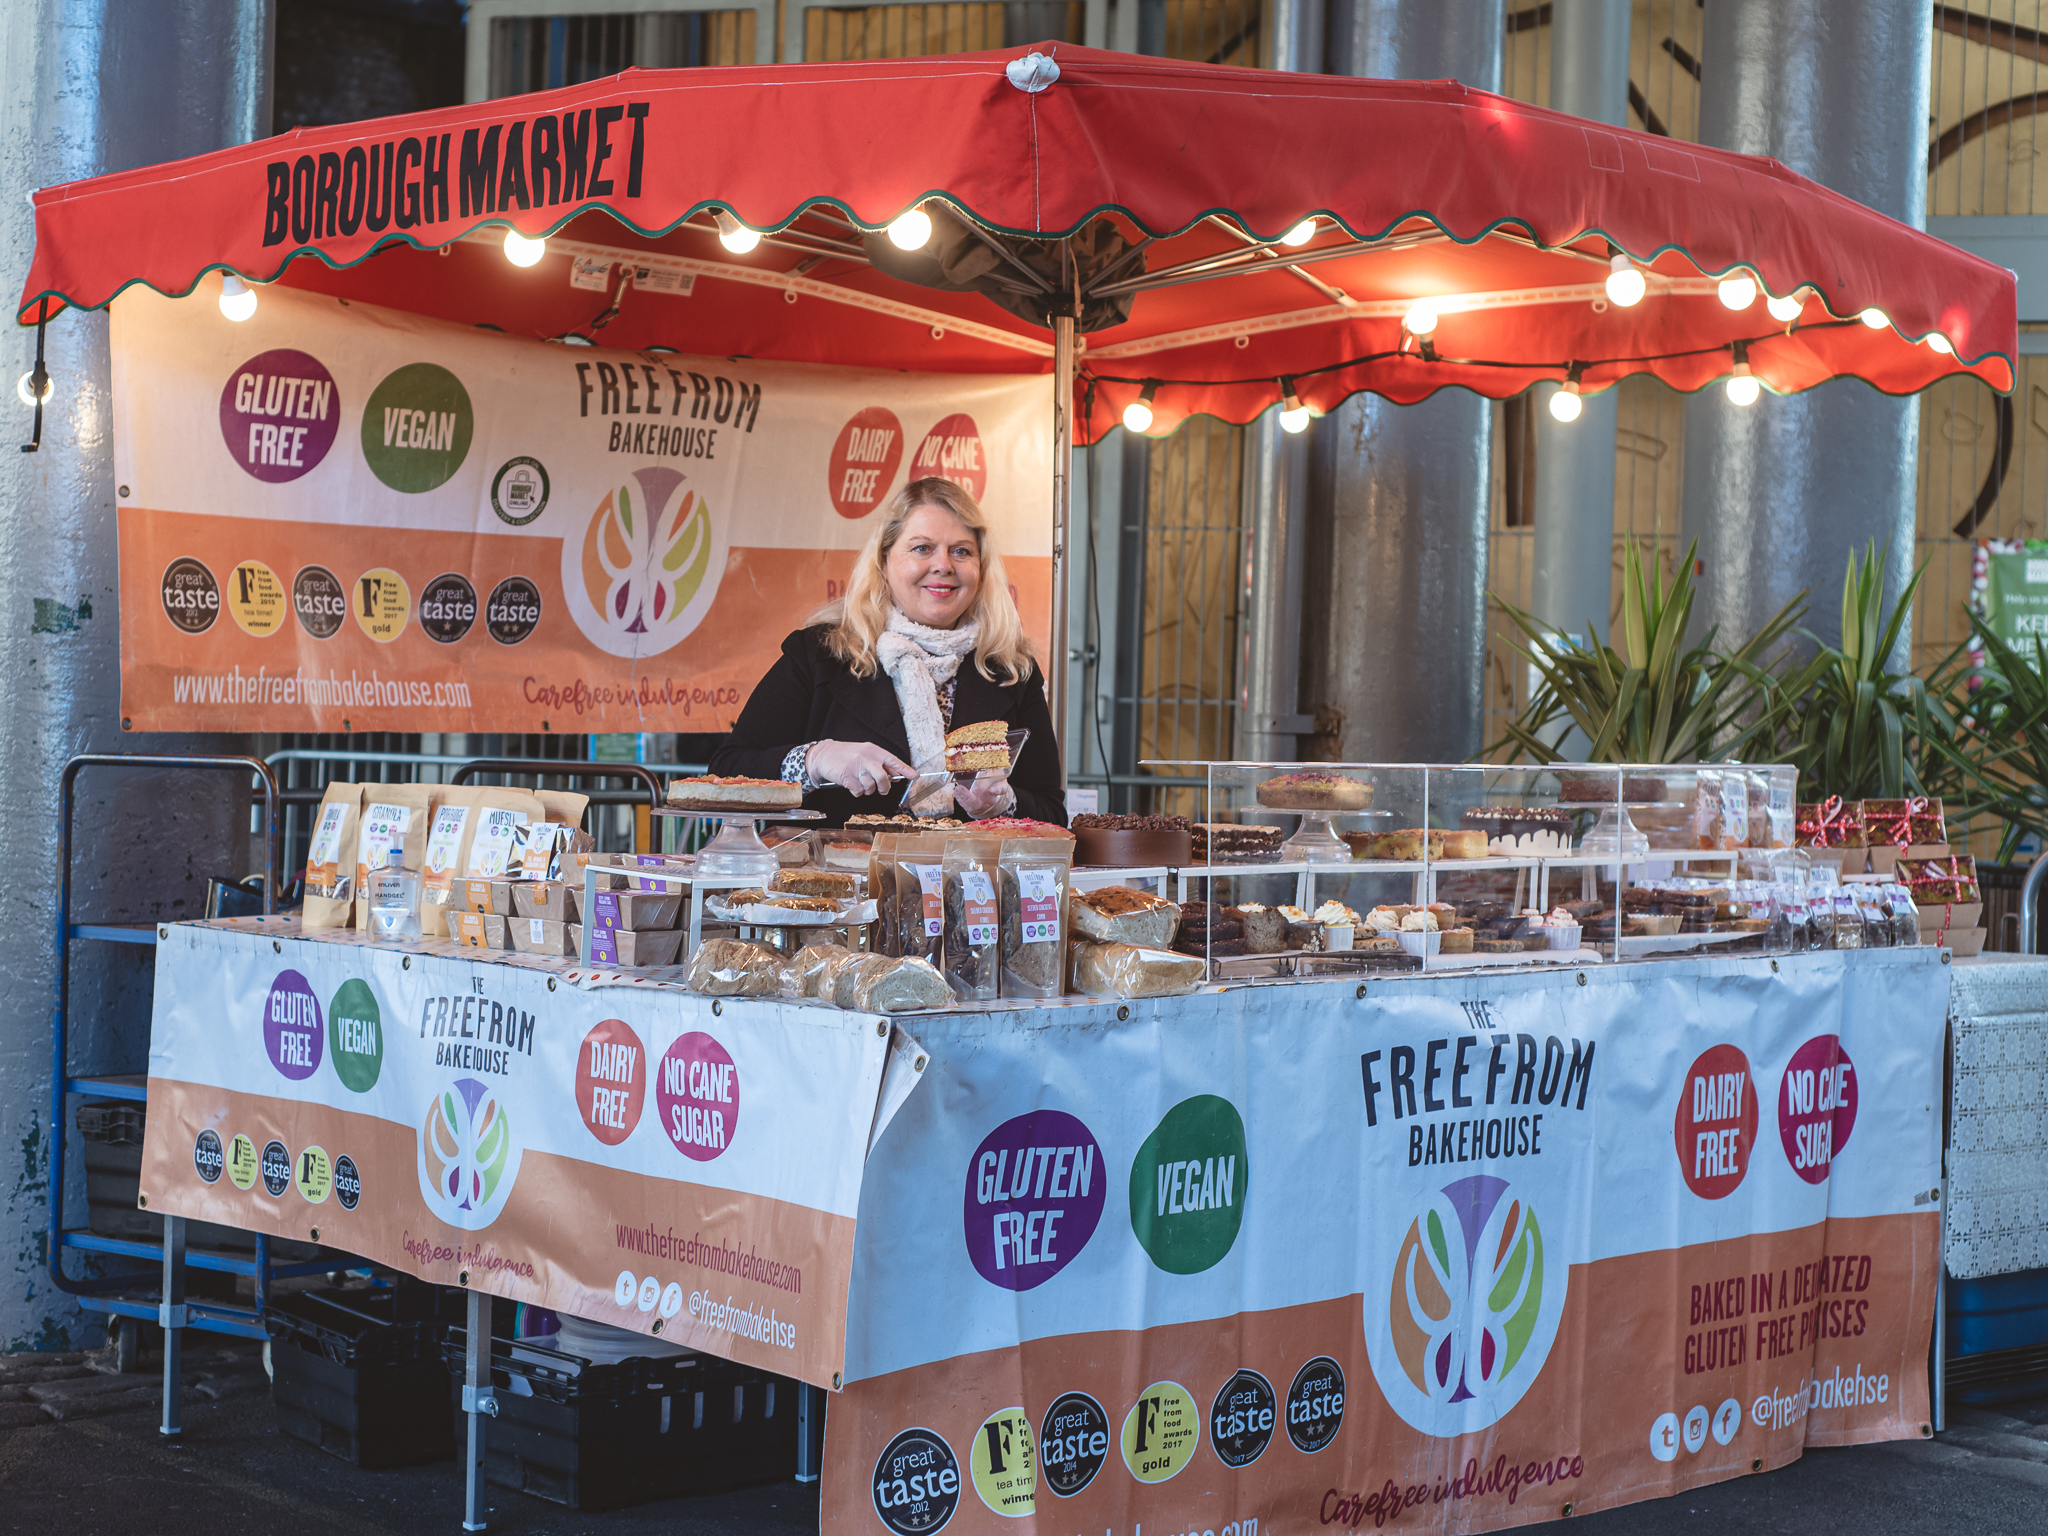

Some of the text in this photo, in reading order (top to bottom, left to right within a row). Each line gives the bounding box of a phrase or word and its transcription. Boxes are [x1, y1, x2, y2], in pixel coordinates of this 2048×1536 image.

[262, 102, 650, 247] BOROUGH MARKET
[235, 372, 331, 421] GLUTEN
[575, 362, 761, 433] FREE FROM
[249, 422, 308, 467] FREE
[383, 407, 456, 451] VEGAN
[609, 421, 717, 459] BAKEHOUSE
[846, 427, 895, 463] DAIRY
[531, 460, 540, 468] ON
[917, 435, 980, 471] NO CANE
[840, 468, 881, 503] FREE
[493, 498, 510, 522] DELIVERY
[516, 501, 546, 525] COLLECTION
[164, 586, 219, 610] taste
[175, 573, 204, 588] great
[237, 567, 255, 604] F
[303, 579, 331, 594] great
[361, 578, 381, 617] F
[436, 588, 464, 601] great
[502, 590, 529, 604] great
[185, 608, 198, 616] 2012
[295, 592, 344, 615] taste
[422, 600, 474, 621] taste
[490, 603, 538, 622] taste
[247, 620, 271, 628] winner
[372, 624, 391, 634] gold
[173, 665, 472, 708] www.thefreefrombakehouse.com
[523, 676, 740, 717] Carefree indulgence
[372, 806, 402, 821] GRANOLA
[489, 811, 516, 827] MUESLI
[271, 989, 317, 1029] GLUTEN
[420, 996, 536, 1057] FREE FROM
[1460, 1000, 1496, 1029] THE
[279, 1030, 313, 1067] FREE
[337, 1016, 376, 1057] VEGAN
[590, 1040, 637, 1084] DAIRY
[664, 1056, 735, 1104] NO CANE
[1361, 1033, 1596, 1127] FREE FROM
[1693, 1071, 1745, 1123] DAIRY
[1787, 1063, 1852, 1116] NO CAE
[591, 1086, 630, 1130] FREE
[671, 1104, 726, 1150] SUGAR
[1408, 1114, 1543, 1167] BAKEHOUSE
[196, 1148, 223, 1167] taste
[201, 1140, 217, 1151] great
[233, 1138, 243, 1165] F
[268, 1150, 284, 1162] great
[1695, 1128, 1740, 1179] FREE
[263, 1160, 291, 1180] taste
[301, 1153, 316, 1184] F
[335, 1173, 360, 1194] taste
[339, 1163, 353, 1176] great
[976, 1144, 1094, 1205] GLUTEN
[1157, 1155, 1236, 1217] VEGAN
[308, 1189, 322, 1197] gold
[403, 1230, 534, 1280] Carefree indulgence
[993, 1209, 1065, 1270] FREE
[616, 1223, 801, 1294] www.thefreefrombakehouse.com
[1690, 1277, 1745, 1326] BAKED
[1750, 1272, 1773, 1314] IN
[1778, 1270, 1788, 1310] A
[688, 1289, 796, 1349] @freefrombakehse
[1684, 1323, 1748, 1375] GLUTEN
[1756, 1314, 1796, 1362] FREE
[1163, 1398, 1180, 1406] free
[1303, 1374, 1332, 1399] great
[1751, 1363, 1889, 1431] @freefrobakehse
[1054, 1409, 1090, 1437] great
[1135, 1397, 1160, 1454] F
[1163, 1408, 1182, 1416] from
[1163, 1419, 1181, 1428] food
[1214, 1406, 1273, 1439] taste
[1289, 1392, 1343, 1425] taste
[984, 1419, 1014, 1475] F
[1041, 1429, 1107, 1467] taste
[1162, 1440, 1183, 1450] 2017
[1163, 1429, 1192, 1438] awards
[893, 1446, 936, 1477] great
[1142, 1456, 1170, 1473] gold
[876, 1467, 958, 1509] taste
[996, 1479, 1013, 1491] tea
[1320, 1454, 1584, 1529] Carefree indulgence
[910, 1500, 930, 1514] 2012
